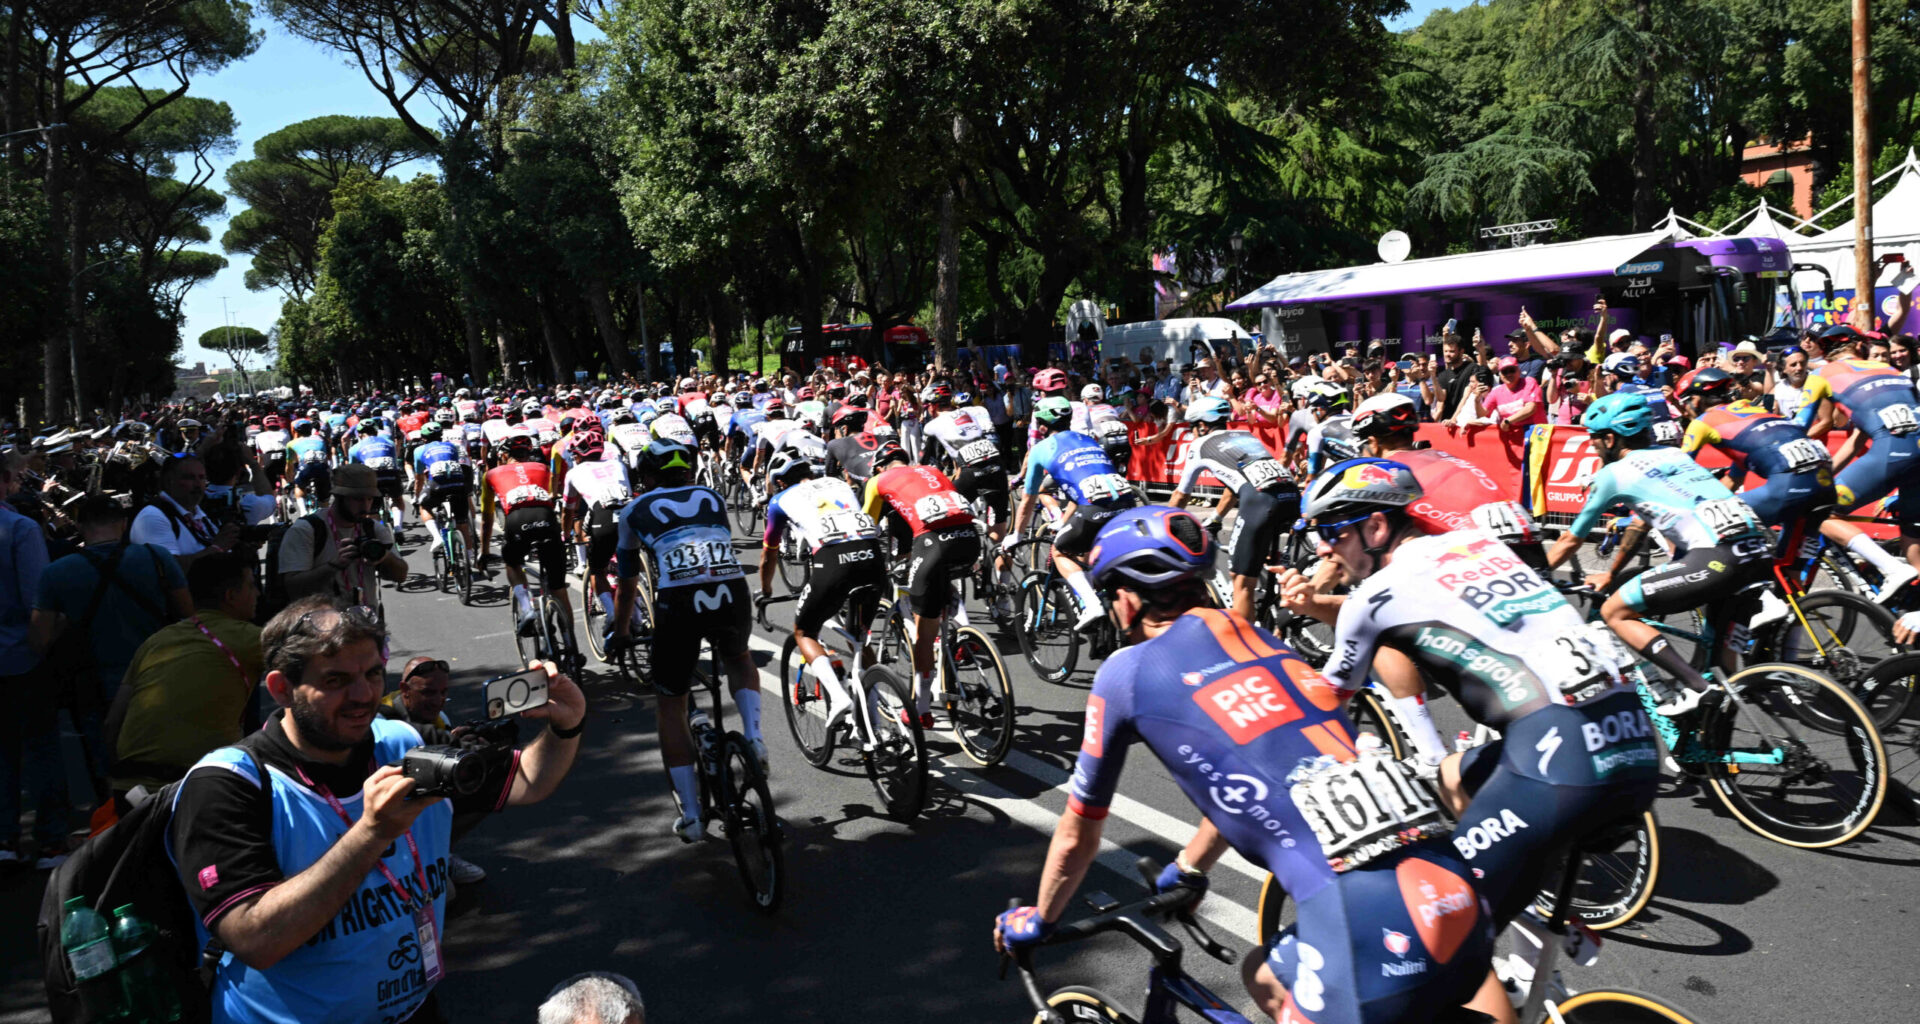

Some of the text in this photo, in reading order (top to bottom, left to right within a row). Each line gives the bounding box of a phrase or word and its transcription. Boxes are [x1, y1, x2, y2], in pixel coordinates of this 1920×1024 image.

[1621, 263, 1660, 274] Jayco
[1275, 308, 1305, 318] Jayco
[1535, 318, 1554, 328] eam
[1413, 502, 1472, 531] Cofidi
[1488, 507, 1516, 533] 44
[938, 529, 976, 542] Cofidis
[666, 545, 700, 569] 123
[838, 549, 875, 565] INEOS
[1458, 570, 1543, 609] BOR
[1335, 639, 1359, 681] BORA
[1416, 627, 1529, 703] hansgrohe
[1211, 675, 1272, 712] PIC
[1581, 710, 1656, 752] BORA
[1177, 744, 1224, 783] eyes
[1246, 803, 1298, 849] more
[1453, 808, 1529, 860] BORA
[1381, 957, 1427, 978] Nalini
[377, 976, 401, 1002] Giro
